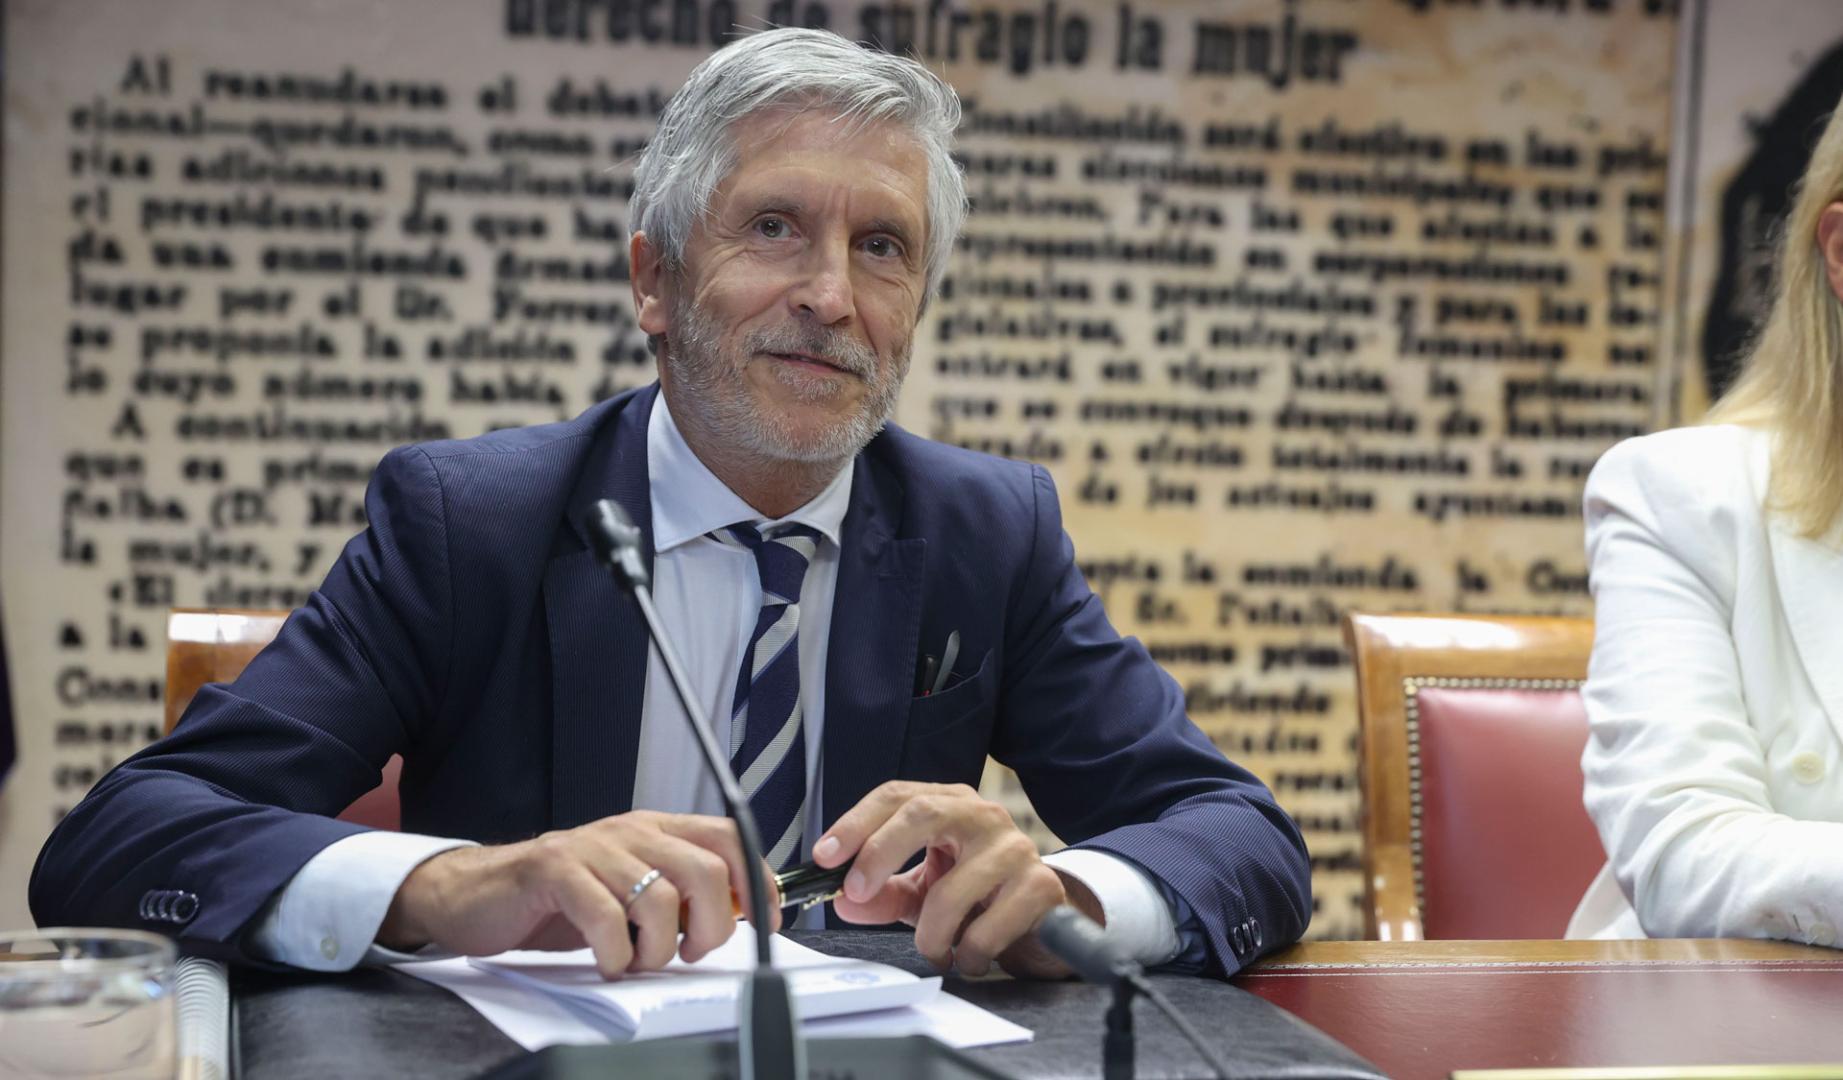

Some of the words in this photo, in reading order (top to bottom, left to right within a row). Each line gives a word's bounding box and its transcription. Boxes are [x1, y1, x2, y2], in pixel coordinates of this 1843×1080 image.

[122, 55, 171, 95] Al
[479, 76, 515, 112] el
[548, 78, 654, 116] debat
[496, 248, 626, 284] firmad
[112, 401, 147, 440] A
